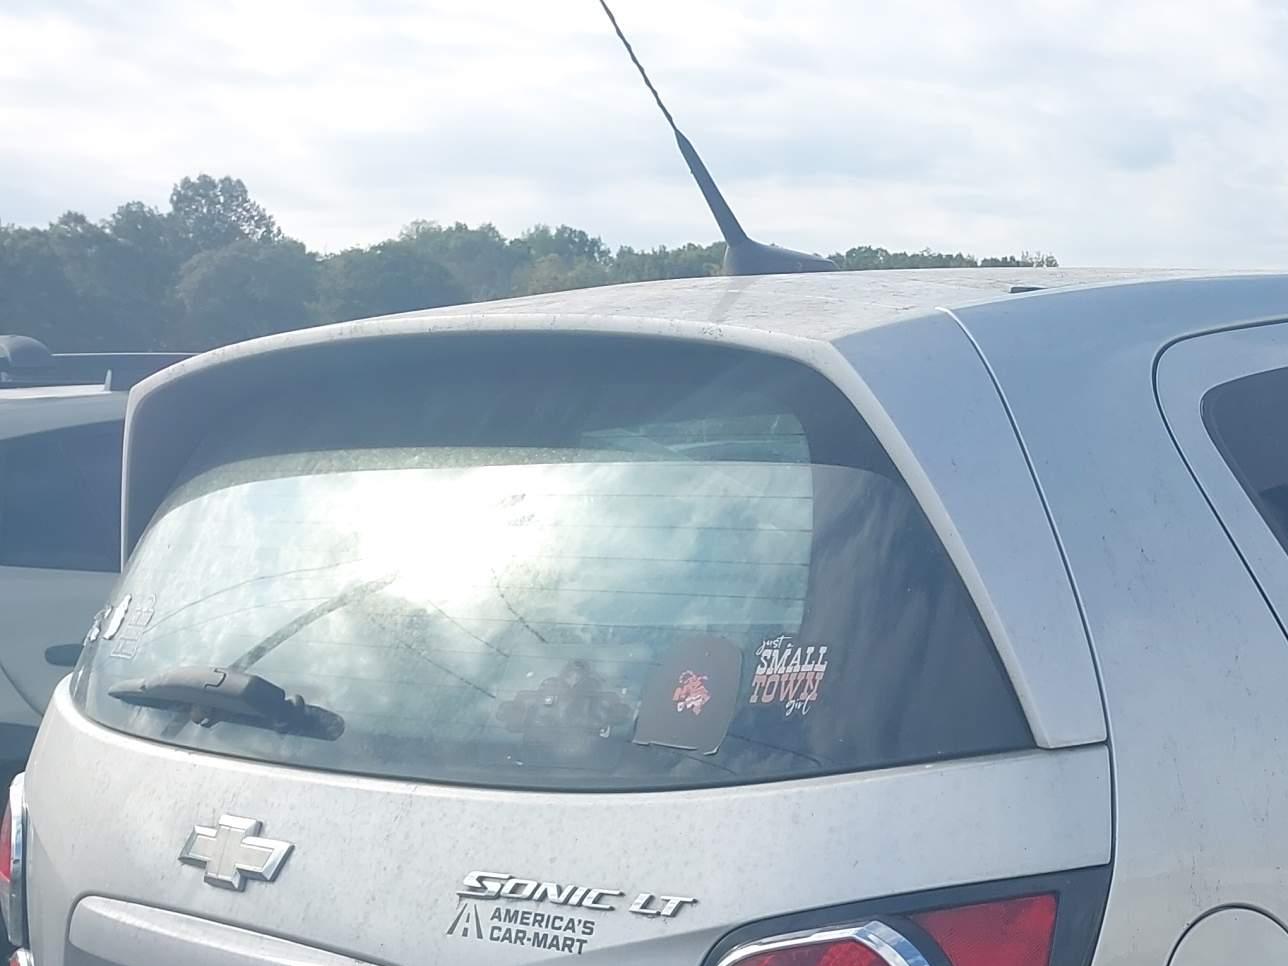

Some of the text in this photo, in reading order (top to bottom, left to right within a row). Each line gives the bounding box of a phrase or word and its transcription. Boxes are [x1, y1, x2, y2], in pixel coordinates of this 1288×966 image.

[756, 635, 792, 655] just
[756, 646, 828, 674] SMALL
[750, 671, 824, 703] TOWN
[456, 871, 699, 917] SONIC LT
[490, 907, 595, 936] AMERICA'S
[489, 926, 588, 955] CAR-MART
